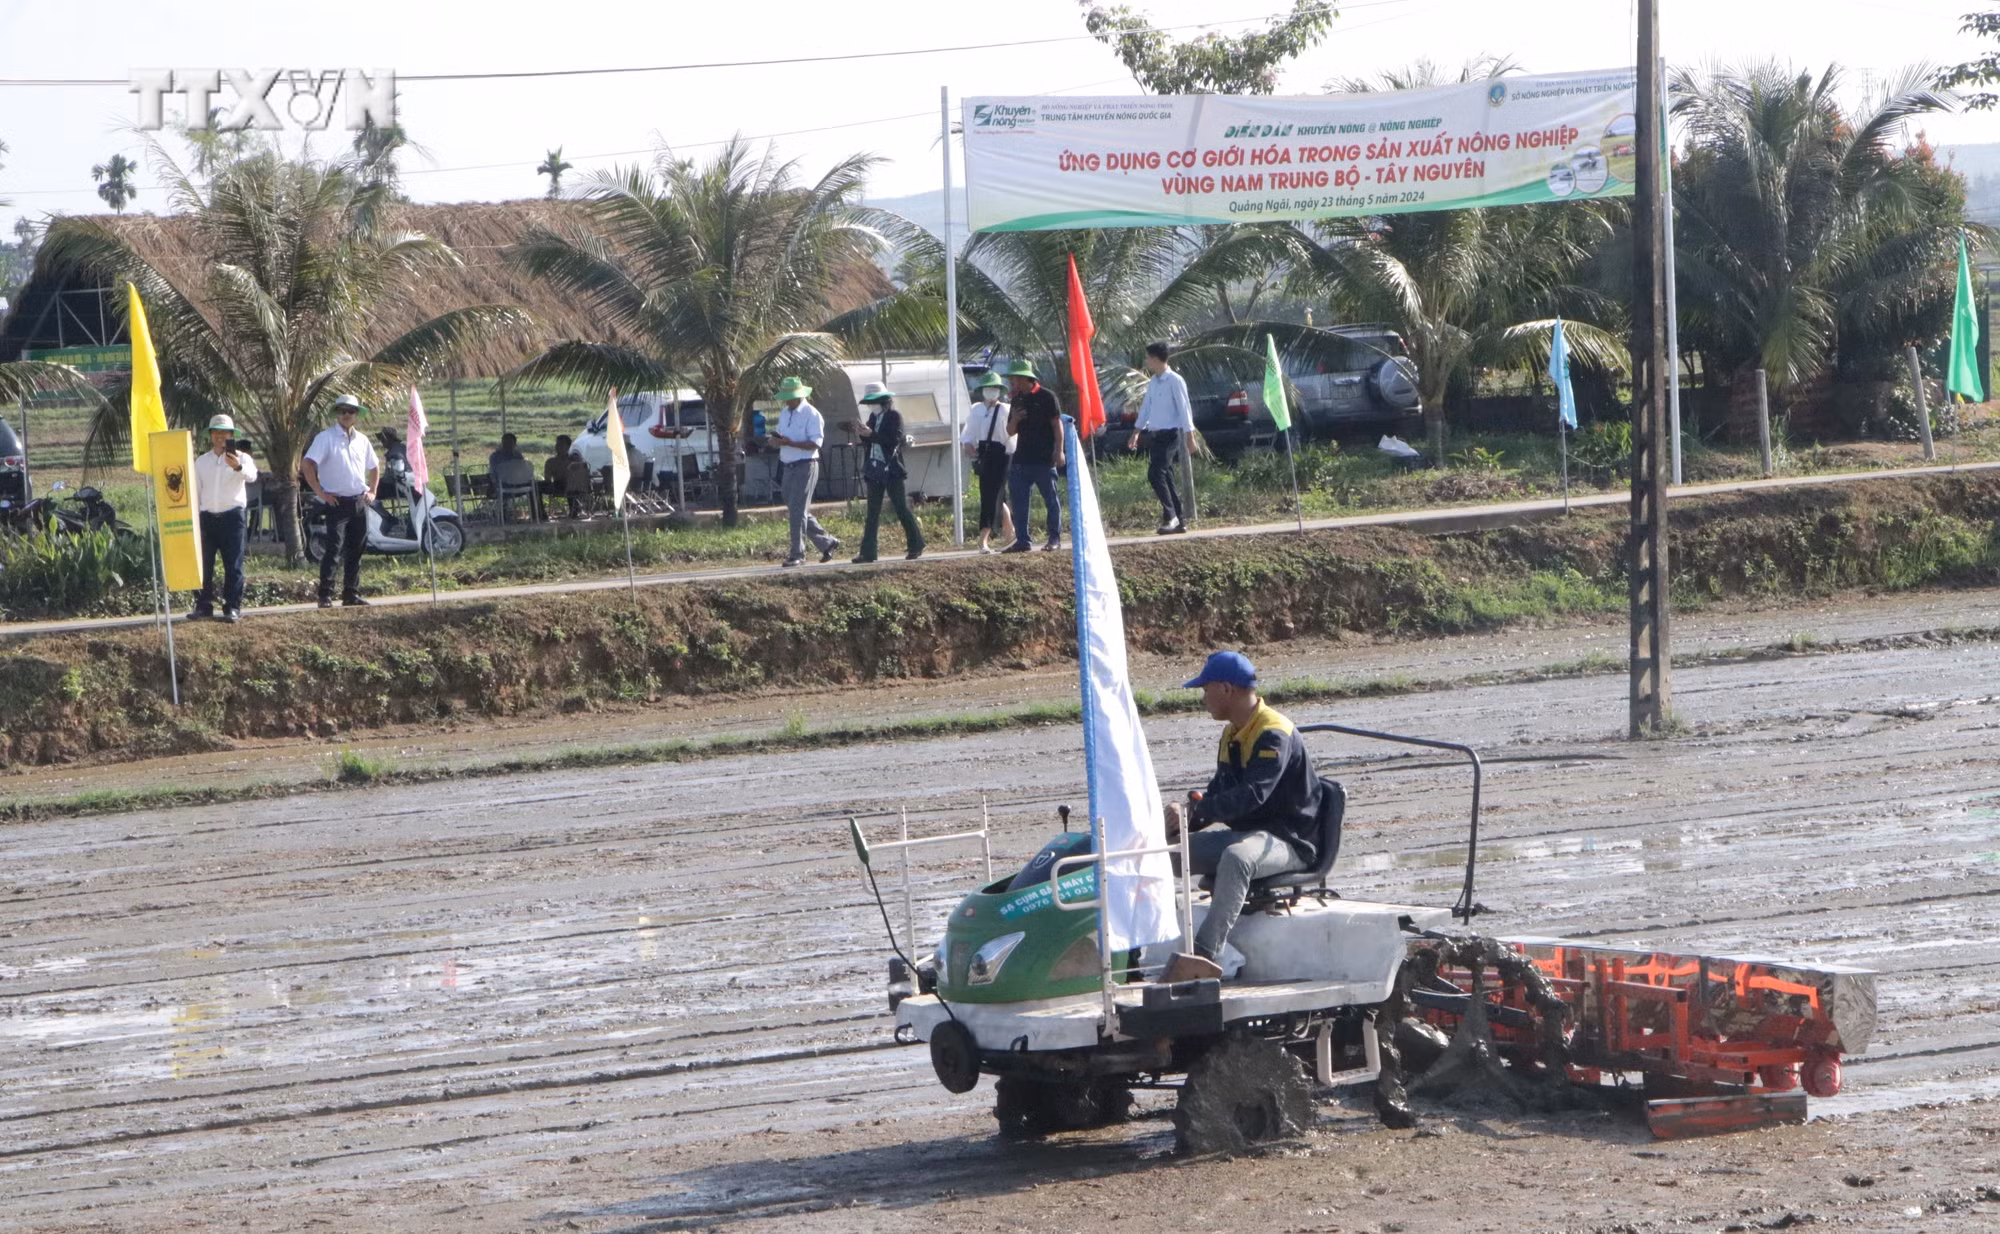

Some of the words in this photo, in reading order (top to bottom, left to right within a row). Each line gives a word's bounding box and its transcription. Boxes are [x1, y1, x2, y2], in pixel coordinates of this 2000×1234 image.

[1521, 91, 1540, 100] NÔNG
[1541, 89, 1565, 99] NGHIỆP
[1566, 86, 1575, 96] VÀ
[1576, 85, 1592, 95] PHÁT
[1594, 83, 1612, 93] TRIỂN
[1613, 81, 1631, 91] NÔNG
[994, 105, 1031, 118] Khuyến
[1041, 113, 1066, 121] TRUNG
[1068, 112, 1083, 121] TÂM
[1084, 111, 1116, 121] KHUYẾN
[1116, 111, 1137, 120] NÔNG
[1138, 110, 1159, 120] QUỐC
[1160, 111, 1172, 119] GIA
[992, 117, 1017, 128] nông
[1297, 122, 1337, 136] KHUYẾN
[1338, 121, 1366, 135] NÔNG
[1379, 120, 1406, 132] NÔNG
[1408, 117, 1443, 131] NGHIỆP
[1059, 149, 1100, 172] ỨNG
[1107, 152, 1160, 175] DỤNG
[1167, 148, 1197, 168] CƠ
[1202, 145, 1244, 167] GIỚI
[1250, 144, 1291, 166] HÓA
[1299, 144, 1360, 163] TRONG
[1366, 136, 1402, 160] SẢN
[1406, 131, 1453, 157] XUẤT
[1458, 131, 1510, 154] NÔNG
[1516, 124, 1579, 150] NGHIỆP
[1162, 172, 1215, 195] VÙNG
[1221, 175, 1263, 193] NAM
[1269, 171, 1328, 190] TRUNG
[1334, 165, 1360, 191] BỘ
[1376, 162, 1408, 184] TÂY
[1414, 157, 1485, 182] NGUYÊN
[1229, 200, 1263, 214] Quảng
[1265, 199, 1291, 212] Ngãi,
[1294, 198, 1319, 212] ngày
[1321, 197, 1333, 207] 23
[1335, 195, 1364, 209] tháng
[1367, 194, 1374, 204] 5
[1375, 193, 1398, 204] năm
[1400, 190, 1425, 203] 2024
[1086, 873, 1095, 883] C
